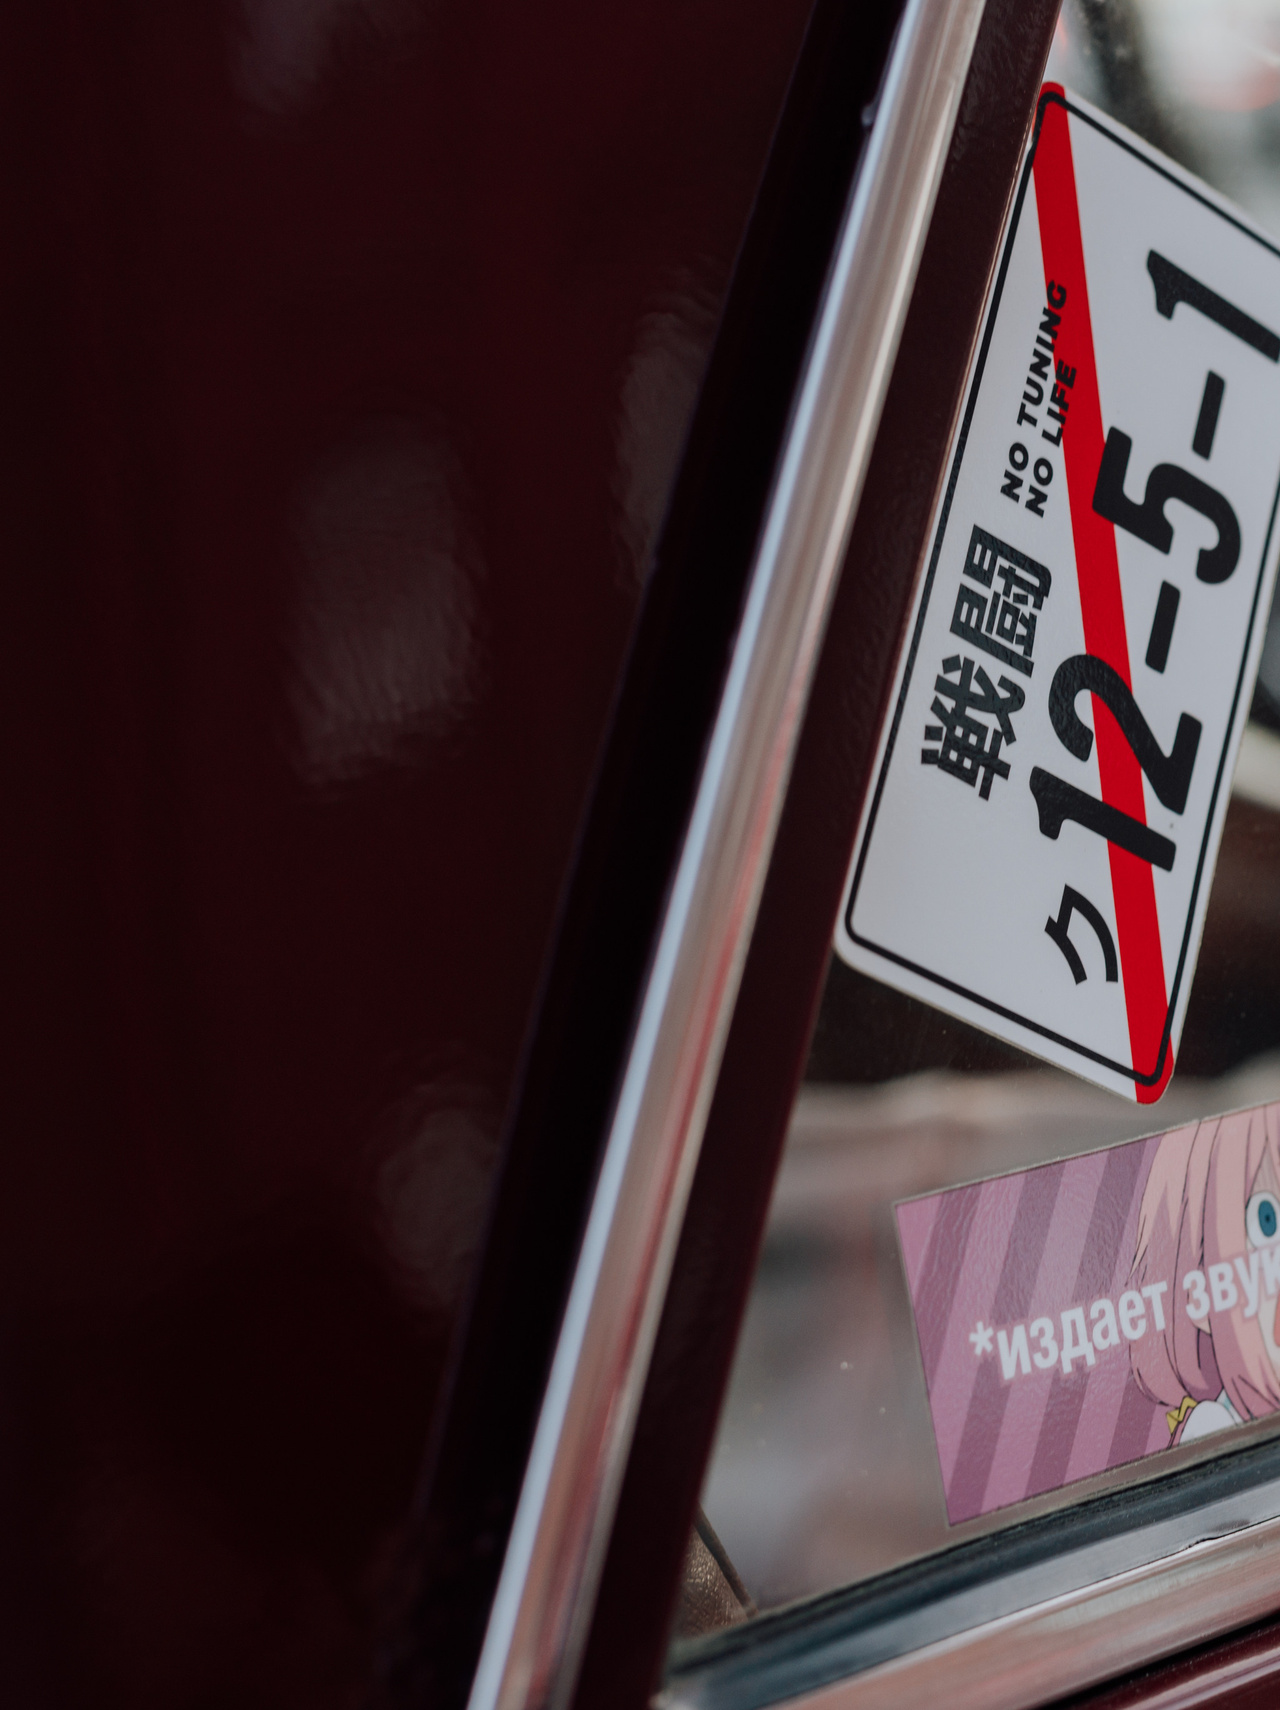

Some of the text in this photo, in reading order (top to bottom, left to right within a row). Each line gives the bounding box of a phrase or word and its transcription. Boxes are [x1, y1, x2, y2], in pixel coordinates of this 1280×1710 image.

[1000, 280, 1067, 503] NO TUNING
[1025, 359, 1077, 518] NO LIFE
[920, 523, 1052, 802] 戦闘
[1044, 883, 1118, 985] ク
